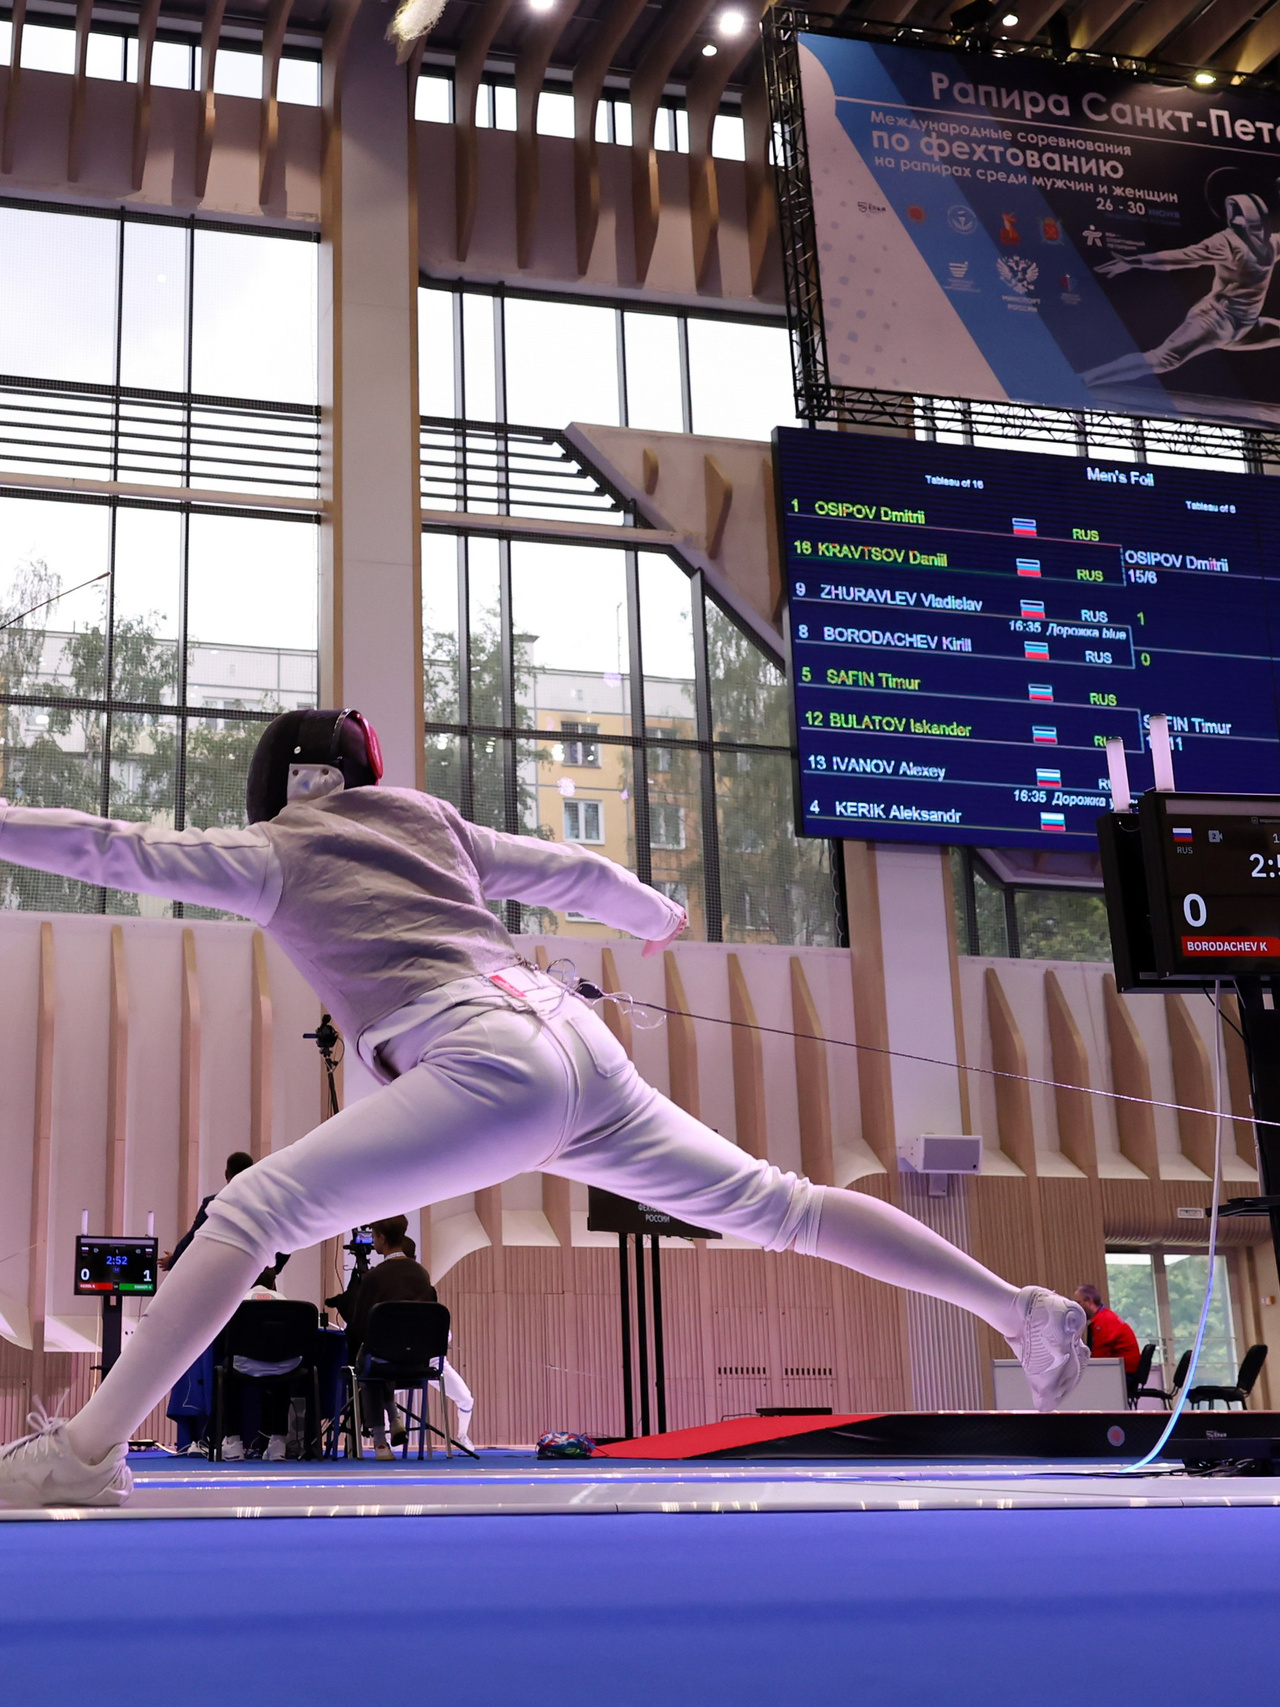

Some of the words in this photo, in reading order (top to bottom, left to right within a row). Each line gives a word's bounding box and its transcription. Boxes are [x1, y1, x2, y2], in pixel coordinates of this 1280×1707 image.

[931, 72, 1070, 119] Рапира
[871, 110, 1012, 140] Международные
[1017, 131, 1132, 156] соревнования
[872, 130, 910, 152] по
[920, 132, 1124, 179] фехтованию
[874, 156, 895, 168] на
[900, 159, 971, 177] рапирах
[976, 169, 1027, 184] среди
[1032, 175, 1094, 192] мужчин
[1099, 184, 1108, 195] и
[1112, 185, 1178, 203] женщин
[1096, 197, 1114, 211] 26
[1127, 201, 1145, 215] 30
[925, 474, 960, 487] Tableau
[961, 478, 971, 488] of
[1086, 467, 1127, 484] Men's
[1130, 472, 1155, 487] Foil
[1219, 504, 1229, 513] of
[791, 499, 799, 512] 1
[815, 501, 877, 519] OSIPOV
[880, 507, 926, 525] Dmitrii
[1072, 528, 1099, 541] RUS
[818, 541, 905, 563] KRAVTSOV
[909, 550, 948, 567] Daniil
[1076, 568, 1104, 582] RUS
[1125, 550, 1183, 568] OSIPOV
[1186, 556, 1229, 573] Dmitrii
[795, 582, 806, 596] 9
[820, 584, 917, 607] ZHURAVLEV
[920, 592, 983, 612] Vladislav
[1081, 609, 1108, 623] RUS
[1136, 611, 1145, 625] 1
[1009, 620, 1042, 633] 16:35
[1046, 623, 1099, 638] Дорожка
[1102, 627, 1127, 640] blue
[798, 624, 809, 639] 8
[823, 626, 938, 649] BORODACHEV
[942, 636, 972, 652] Kirill
[1085, 650, 1113, 664] RUS
[1141, 652, 1151, 666] 0
[801, 666, 812, 681] 5
[826, 668, 875, 687] SAFIN
[878, 672, 921, 690] Timur
[1090, 692, 1117, 706] RUS
[805, 711, 823, 726] 12
[829, 712, 906, 732] BULATOV
[910, 718, 972, 737] Iskander
[1143, 714, 1189, 732] SFIN
[1191, 718, 1232, 735] Timur
[808, 754, 827, 770] 13
[832, 755, 895, 774] IVANOV
[899, 761, 946, 782] Alexey
[1013, 789, 1047, 803] 16:35
[1051, 792, 1106, 807] Дорожка
[809, 799, 820, 814] 4
[835, 801, 886, 819] KERIK
[889, 804, 962, 823] Aleksandr
[1176, 846, 1193, 854] RUS
[1183, 892, 1207, 928] 0
[1187, 941, 1258, 952] BORODACHEV
[1260, 942, 1268, 951] K
[106, 1255, 128, 1265] 2:52
[80, 1268, 90, 1280] 0
[143, 1269, 152, 1282] 1
